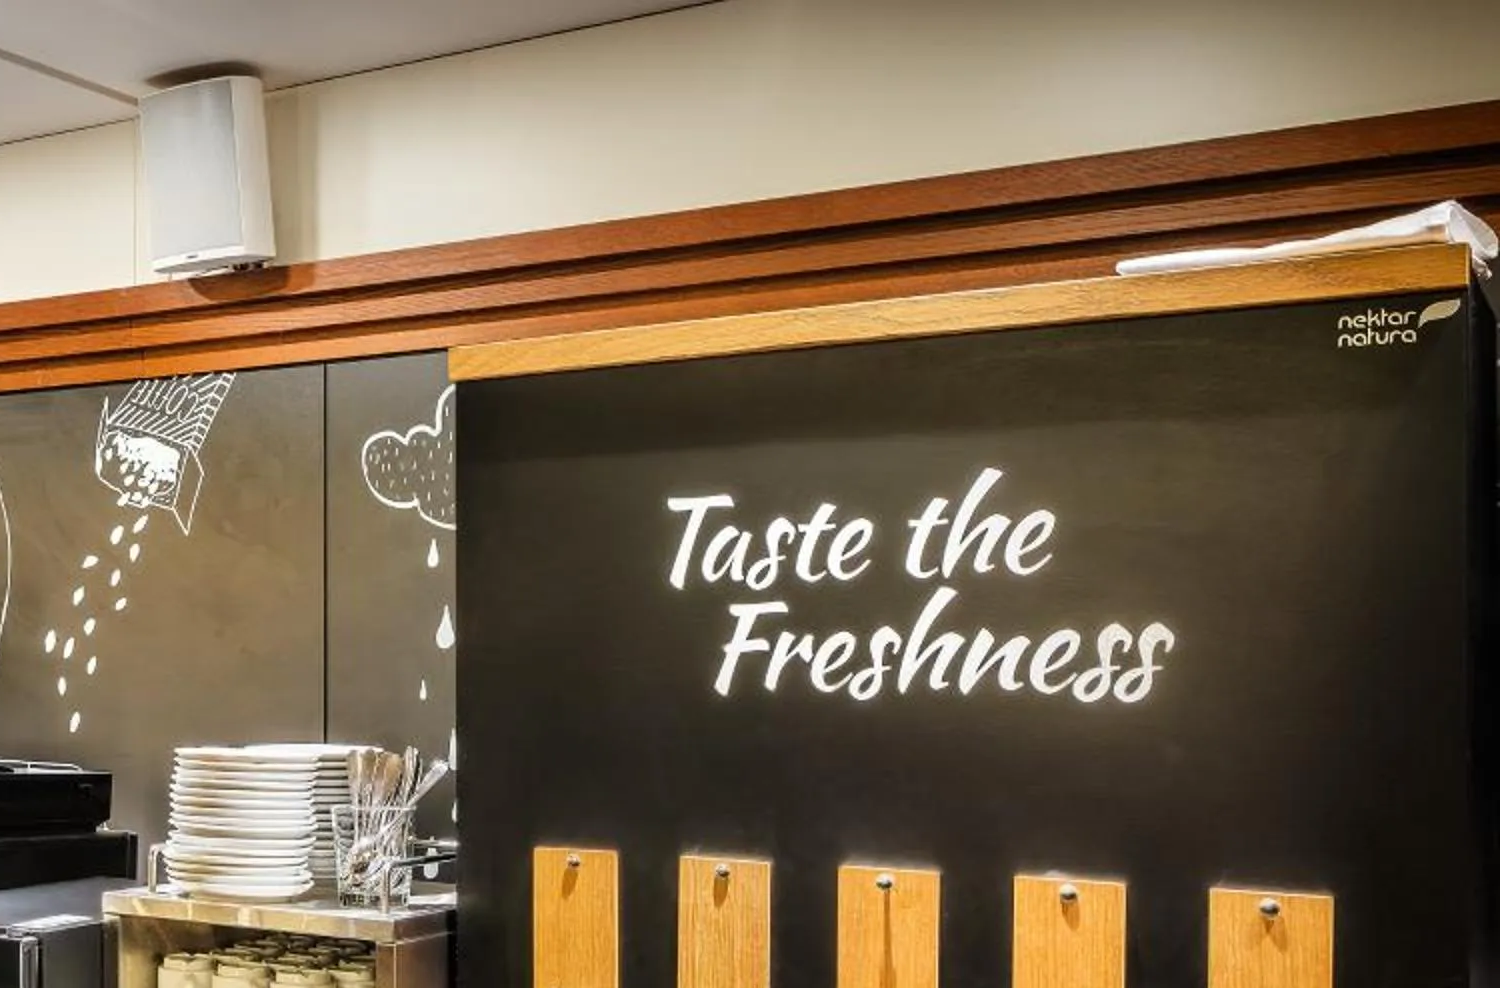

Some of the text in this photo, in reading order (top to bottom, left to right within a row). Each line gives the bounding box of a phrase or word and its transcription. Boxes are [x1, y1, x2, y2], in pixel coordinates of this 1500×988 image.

[1338, 308, 1417, 330] nektar
[1338, 328, 1417, 348] natura
[667, 466, 1057, 591] Taste the
[713, 586, 1176, 703] Freshness
